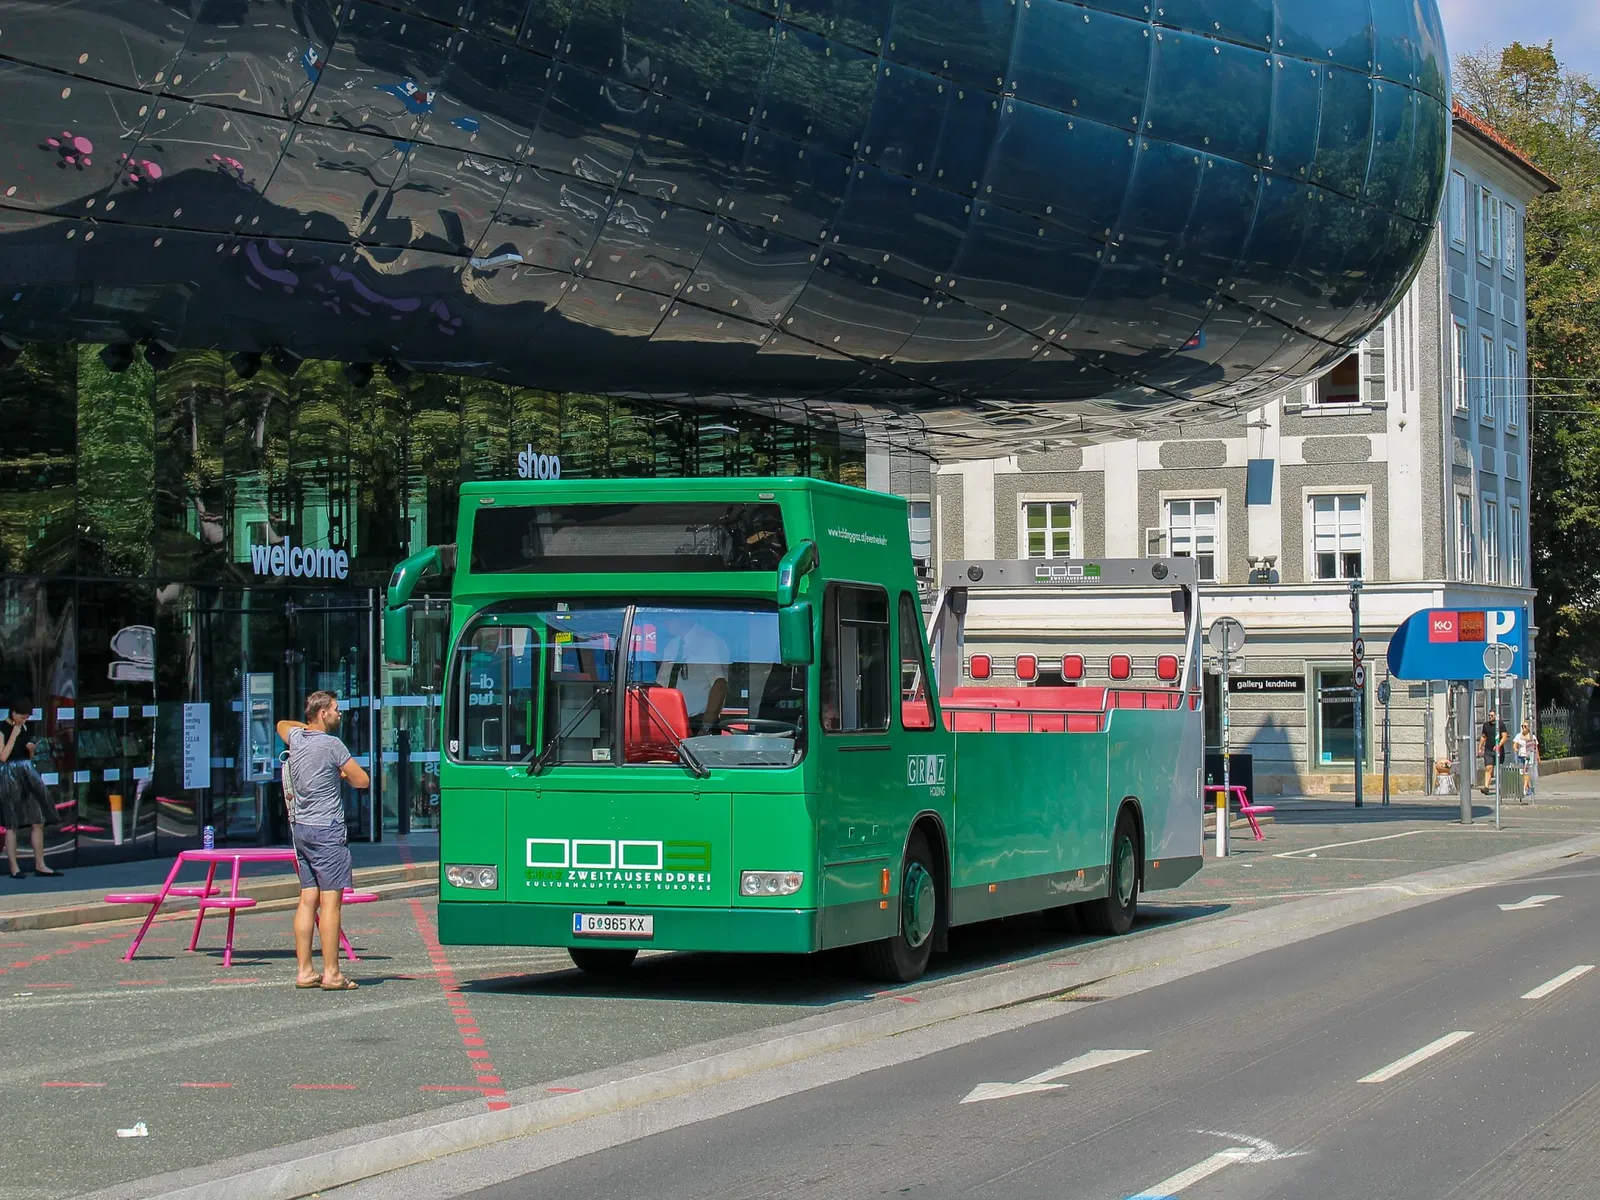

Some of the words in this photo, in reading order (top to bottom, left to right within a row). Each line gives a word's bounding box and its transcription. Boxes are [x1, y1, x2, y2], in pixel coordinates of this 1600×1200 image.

[518, 443, 561, 480] shop
[251, 535, 349, 580] welcome
[1487, 611, 1516, 644] P
[1237, 680, 1264, 690] gallery
[1265, 680, 1297, 688] lendnine
[908, 758, 945, 783] GRAZ
[525, 870, 563, 880] GRAZ
[568, 871, 711, 883] ZWEITAUSENDDREI
[526, 881, 650, 890] KULTURHAUPTSTADT
